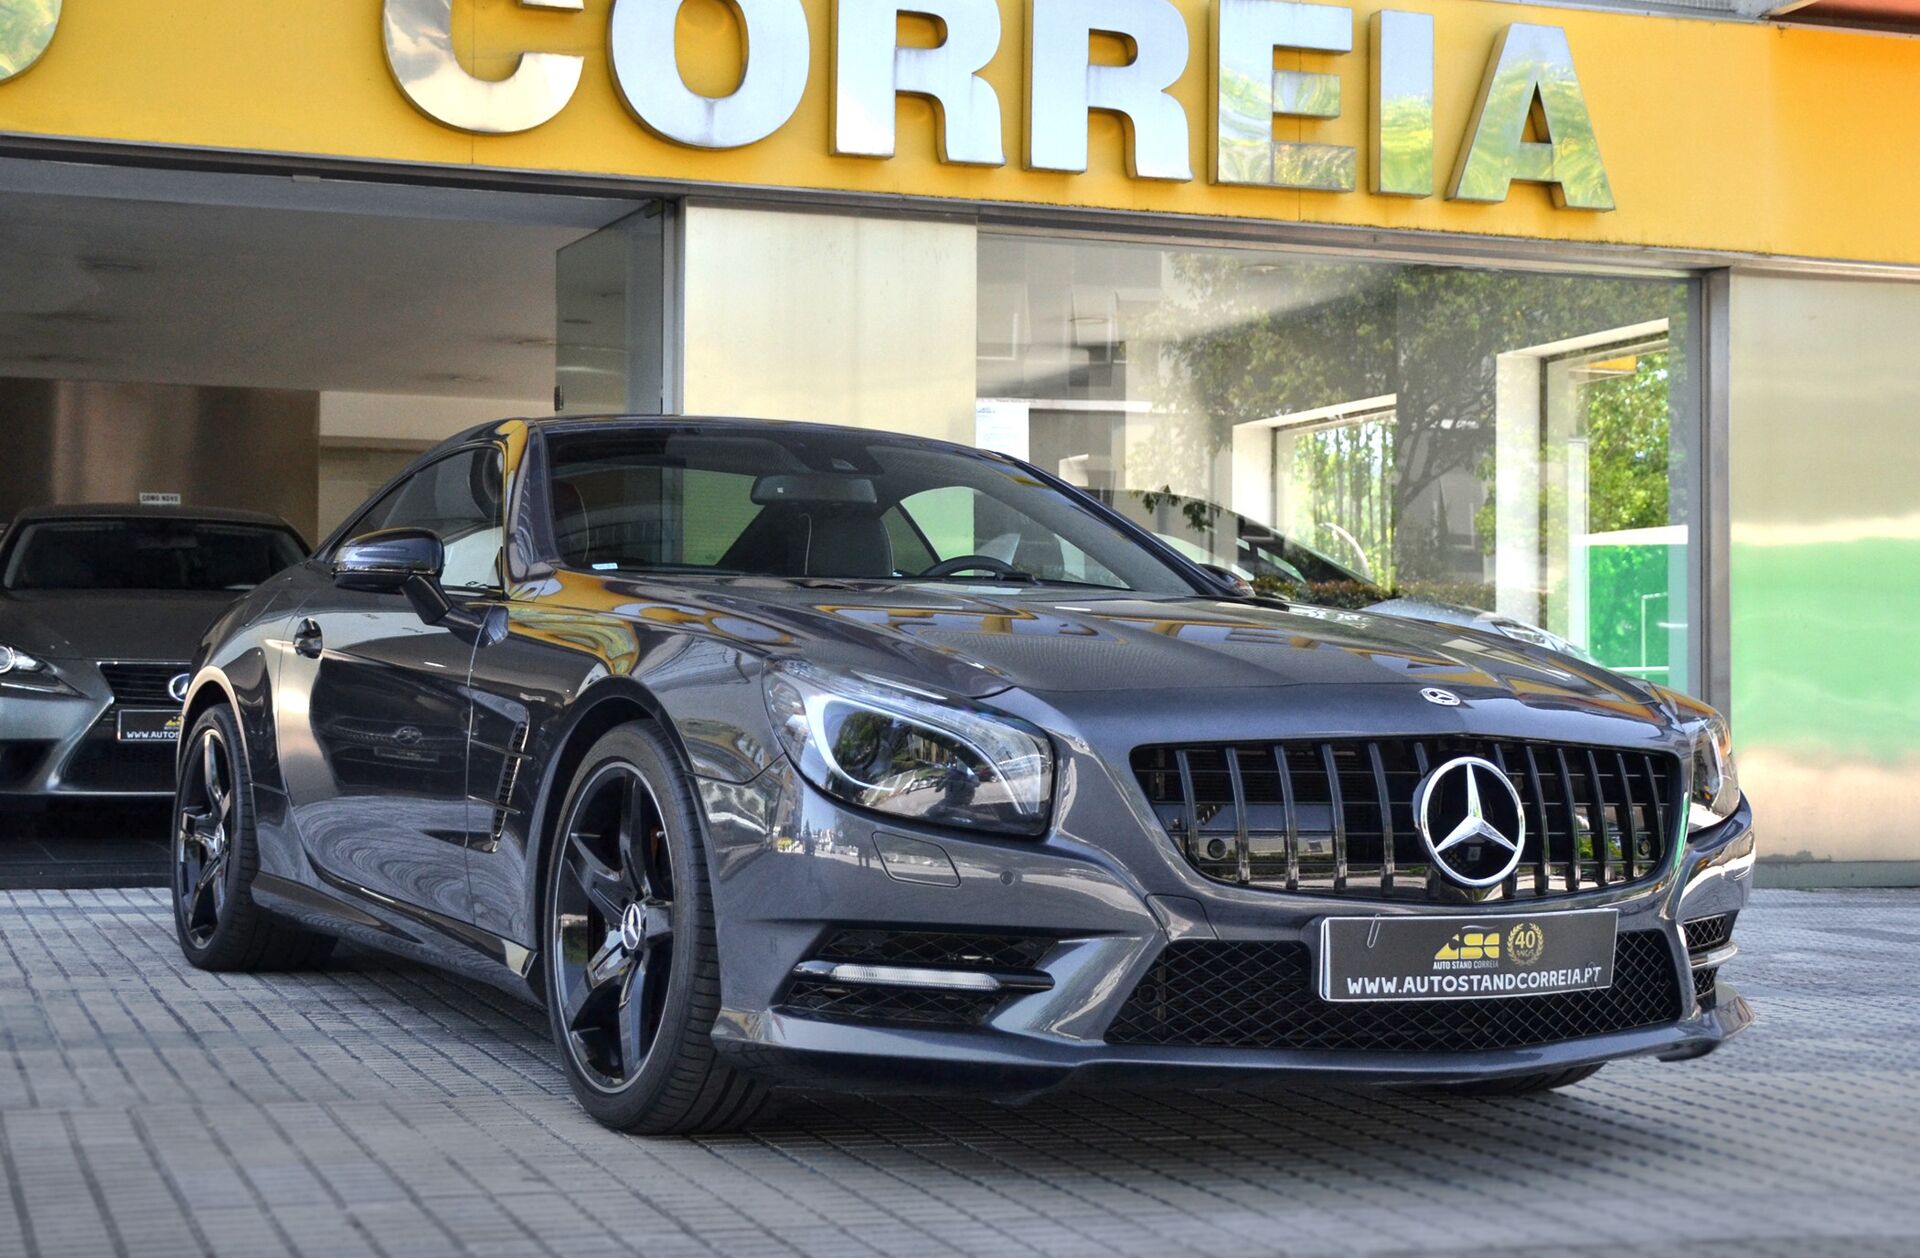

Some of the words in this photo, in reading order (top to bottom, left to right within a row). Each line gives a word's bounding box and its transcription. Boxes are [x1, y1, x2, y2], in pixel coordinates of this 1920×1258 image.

[382, 0, 1617, 213] CORREIA
[1514, 930, 1536, 948] 40
[1433, 961, 1451, 970] AUTO
[1452, 960, 1473, 970] STAND
[1473, 960, 1499, 969] CORREIA
[1347, 967, 1602, 994] WWW.AUTOSTANDCORREIA.PT
